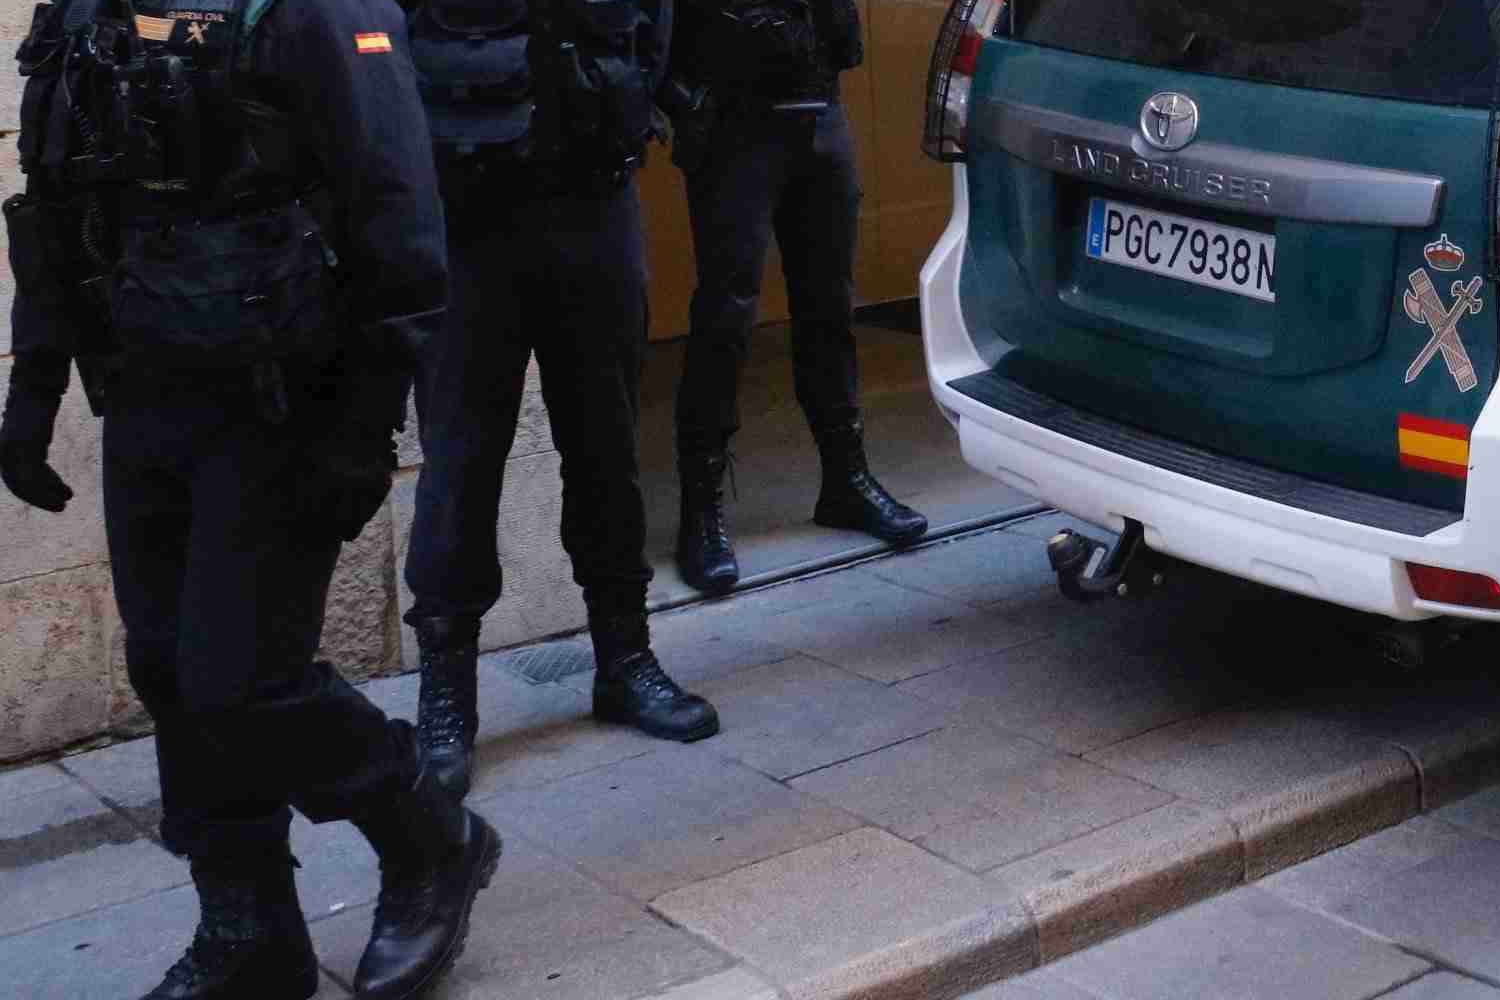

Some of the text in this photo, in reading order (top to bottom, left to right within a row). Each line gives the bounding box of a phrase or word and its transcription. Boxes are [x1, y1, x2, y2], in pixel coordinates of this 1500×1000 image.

[1051, 139, 1271, 204] LAND CRUISER
[1105, 209, 1277, 293] PGC7938N
